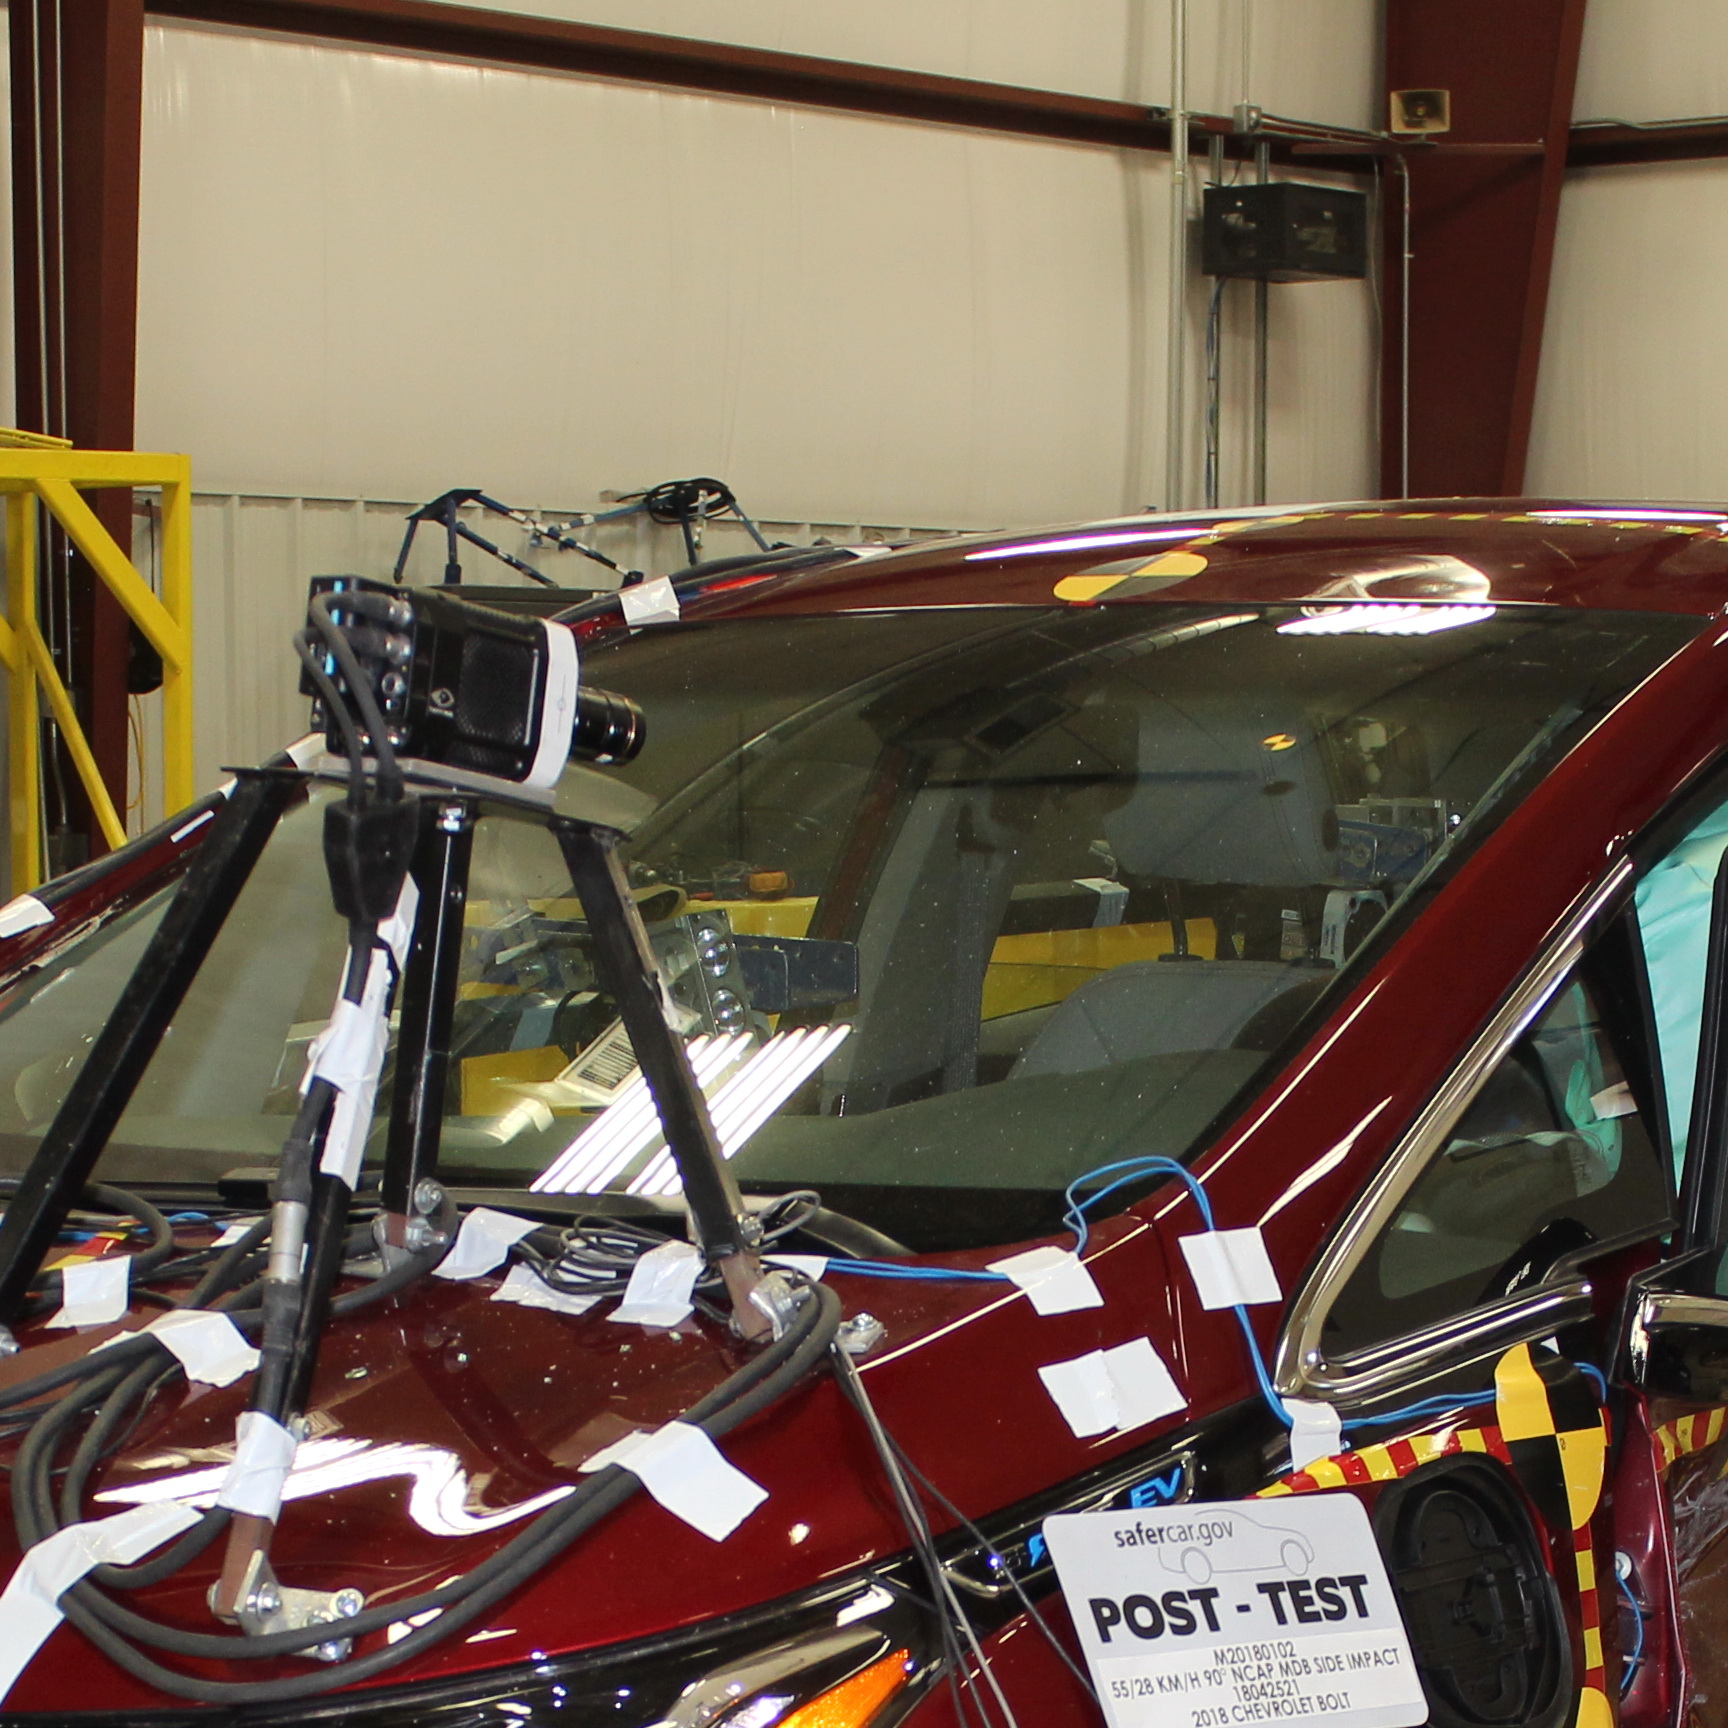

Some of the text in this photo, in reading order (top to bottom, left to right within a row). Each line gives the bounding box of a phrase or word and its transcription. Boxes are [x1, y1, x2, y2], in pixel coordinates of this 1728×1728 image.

[1114, 1519, 1234, 1548] safercar.gov
[1089, 1587, 1221, 1643] POST
[1256, 1574, 1369, 1626] TEST
[1213, 1641, 1297, 1666] M20180102
[1111, 1677, 1155, 1700] 55/28
[1157, 1670, 1202, 1694] KM/H
[1232, 1662, 1274, 1683] NCAP
[1278, 1655, 1312, 1678] MDB
[1314, 1651, 1345, 1673] SIDE
[1346, 1647, 1402, 1671] IMPACT
[1232, 1678, 1301, 1703] 18042521
[1191, 1692, 1352, 1728] 2018 CHEVROLET BOLT
